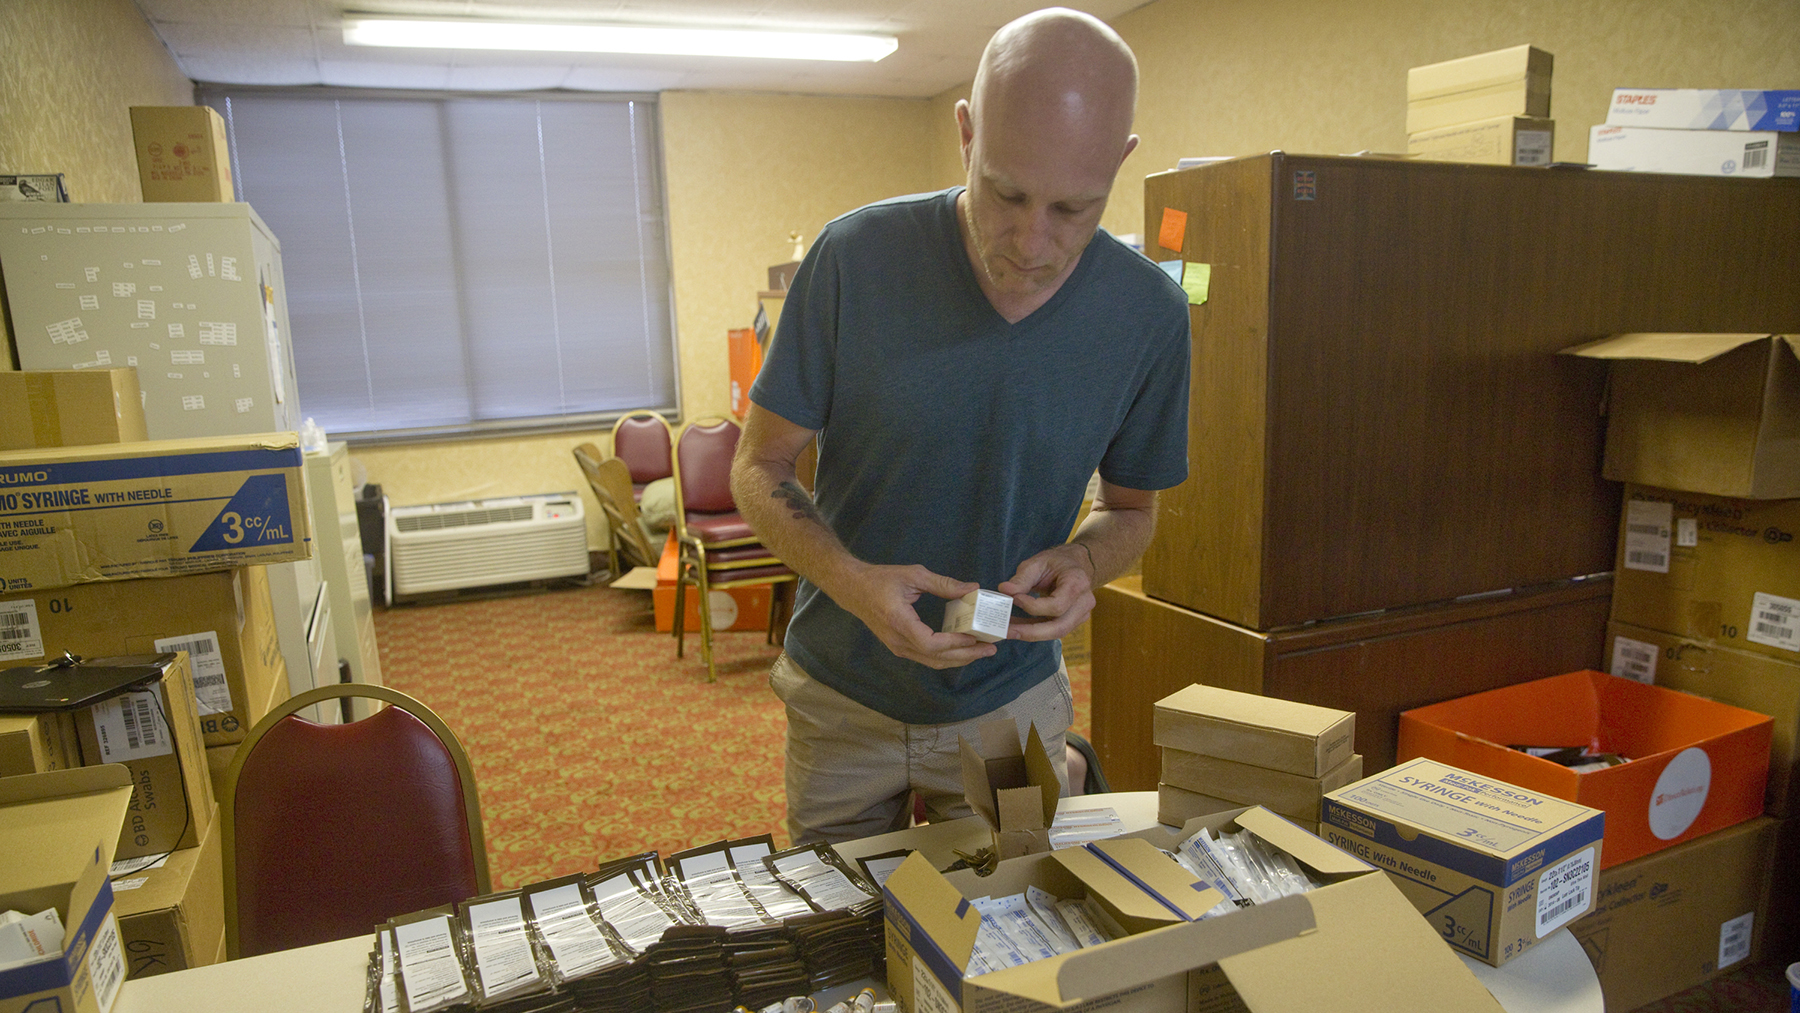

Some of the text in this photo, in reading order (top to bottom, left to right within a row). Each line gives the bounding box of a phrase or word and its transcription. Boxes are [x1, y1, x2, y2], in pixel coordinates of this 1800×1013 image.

[1615, 94, 1657, 105] STAPLES
[22, 488, 91, 510] SYRINGE
[94, 491, 125, 504] WITH
[127, 488, 172, 501] NEEDLE
[13, 519, 45, 528] NEEDLE
[20, 526, 56, 536] AIGUILLE
[221, 511, 289, 544] 3 cc/mL
[49, 598, 73, 613] 10
[1721, 624, 1737, 638] 10
[138, 770, 157, 810] Swabs
[1350, 794, 1368, 802] 100
[1399, 776, 1543, 824] SYRINGE With Needle
[132, 815, 146, 834] BD
[1457, 827, 1479, 838] 3
[1328, 832, 1437, 882] SYRINGE With Needle
[1508, 879, 1535, 903] SYRINGE
[1443, 915, 1482, 951] 3 cc/mL
[1517, 938, 1523, 952] 3
